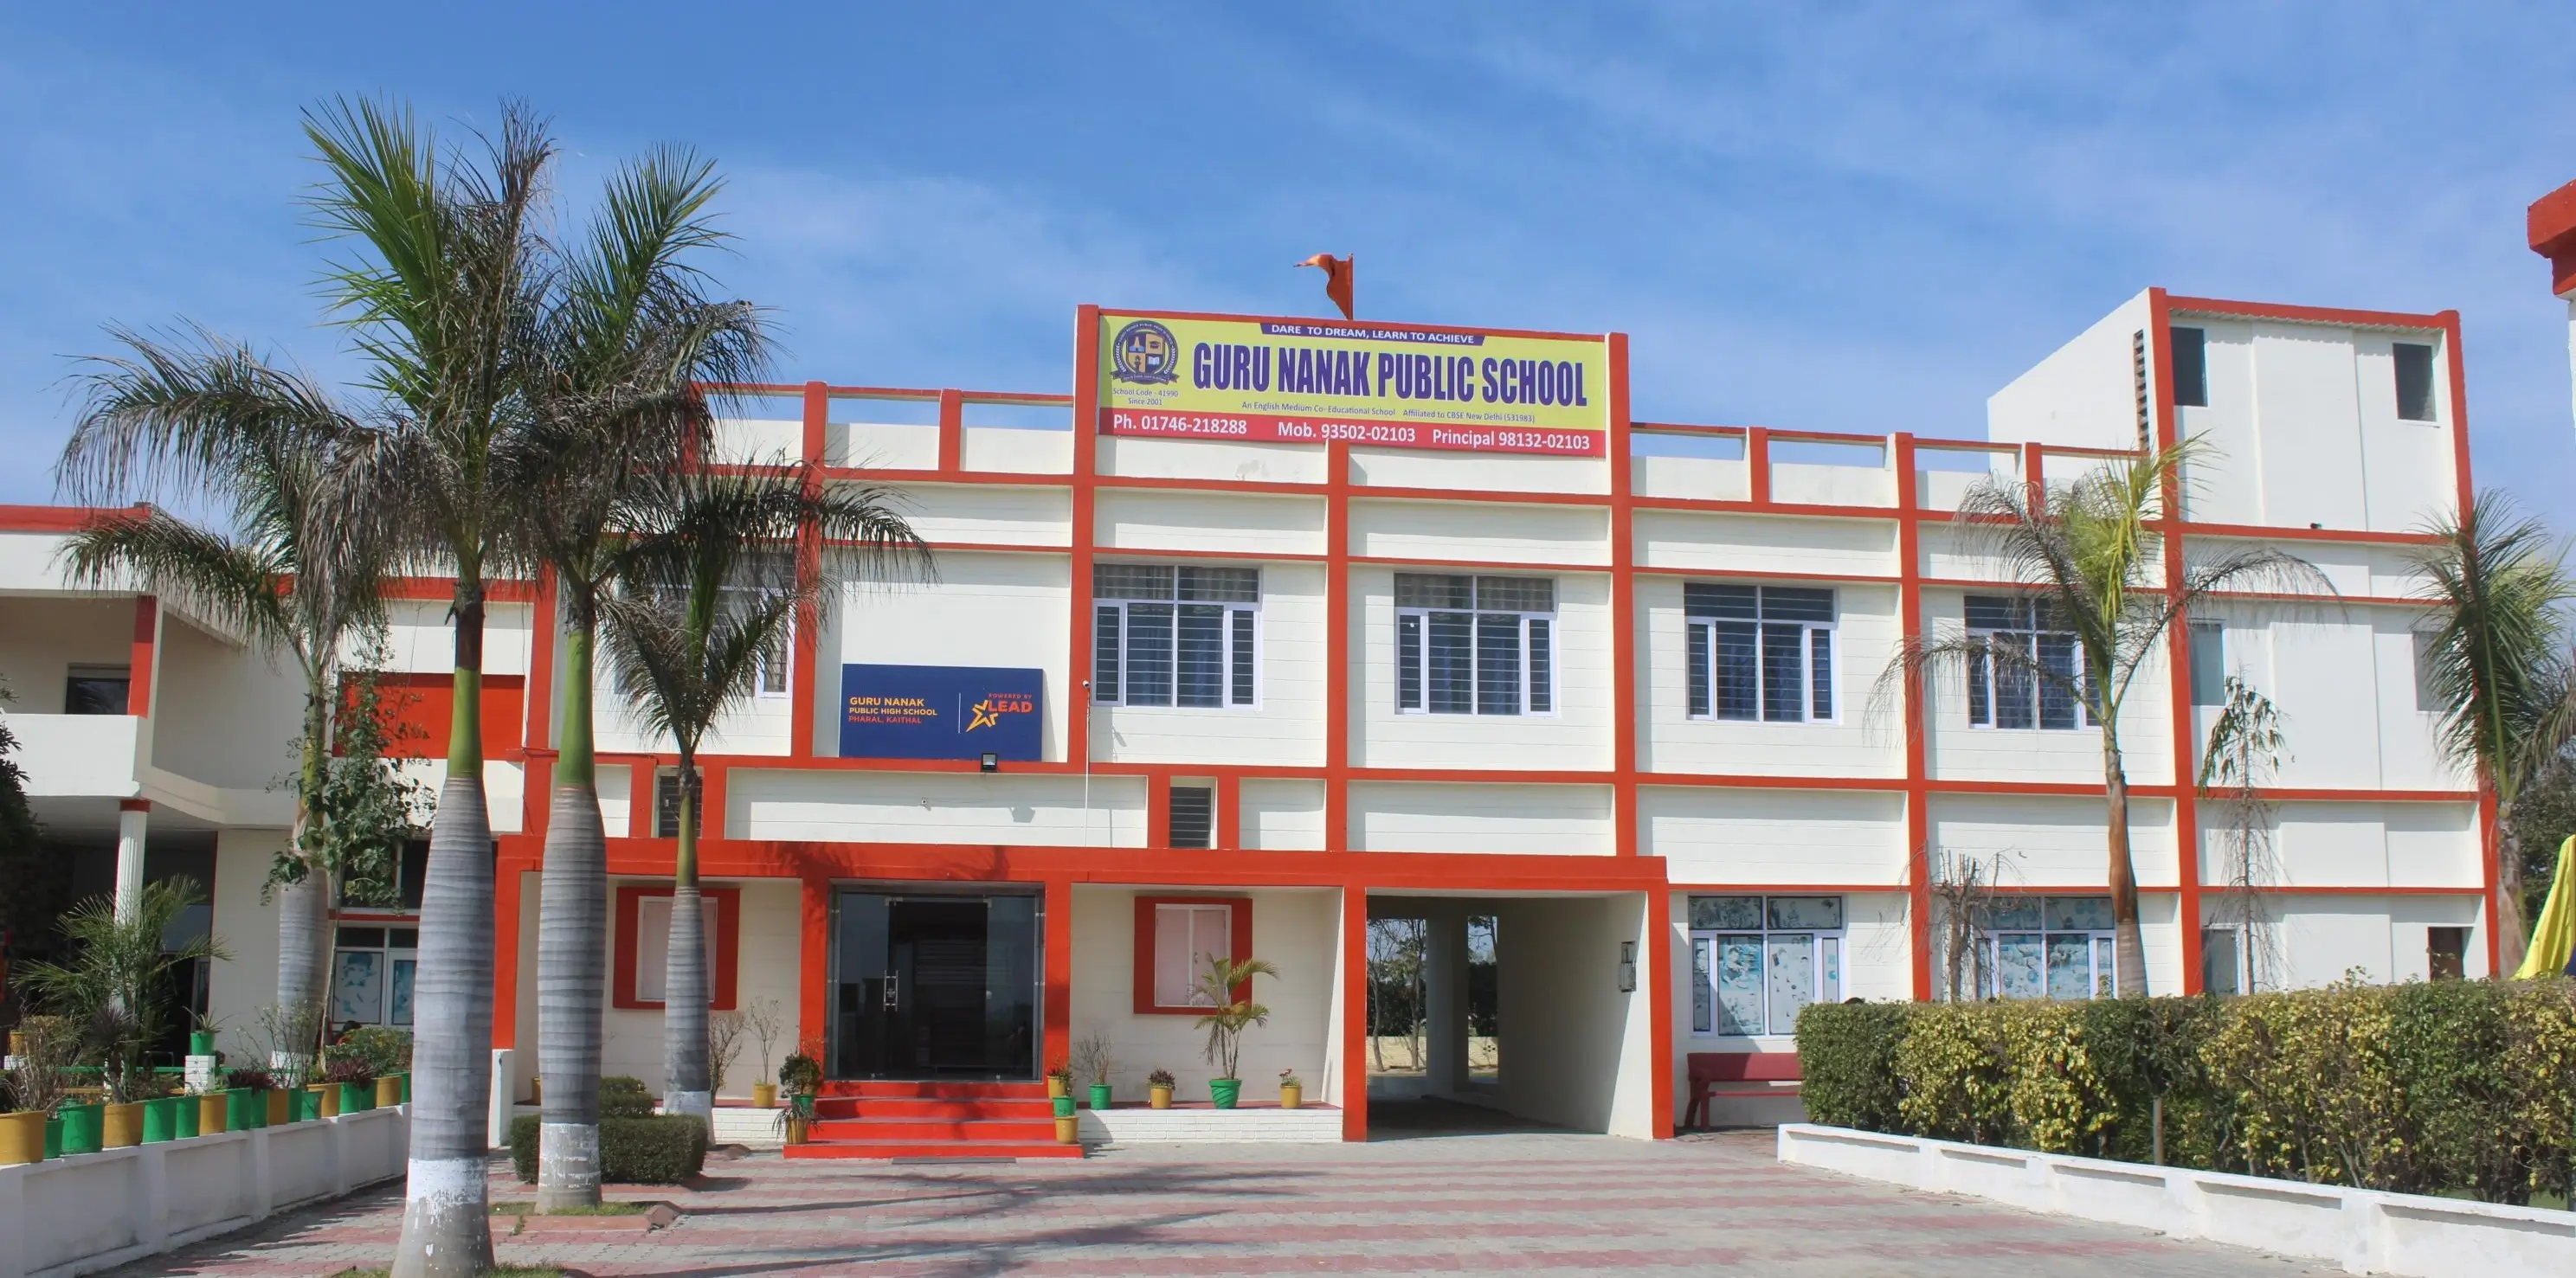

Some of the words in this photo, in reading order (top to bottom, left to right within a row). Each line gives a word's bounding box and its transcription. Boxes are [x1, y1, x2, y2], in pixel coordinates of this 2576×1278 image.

[1272, 324, 1301, 334] DARE
[1307, 326, 1322, 335] TO
[1325, 328, 1369, 339] DREAM,
[1373, 331, 1407, 340] LEARN
[1410, 332, 1425, 341] TO
[1428, 333, 1474, 344] ACHIEVE
[1194, 343, 1270, 392] GURU
[1278, 347, 1370, 396] NANAK
[1378, 353, 1474, 402] PUBLIC
[1482, 357, 1587, 407] SCHOOL
[1254, 402, 1279, 412] English
[1282, 403, 1311, 412] Medium
[1371, 407, 1395, 415] School
[1403, 408, 1435, 418] Affiliated
[1484, 412, 1502, 421] Delhi
[1504, 414, 1535, 423] (531983)
[1114, 414, 1137, 429] Ph.
[1141, 415, 1247, 433] 01746-218288
[1278, 421, 1317, 438] Mob.
[1321, 423, 1415, 442] 93502-02103
[1433, 428, 1494, 448] Principal
[1499, 432, 1590, 450] 98132-02103
[850, 697, 881, 705] GURU
[884, 697, 924, 707] NANAK
[989, 700, 1033, 713] LEAD
